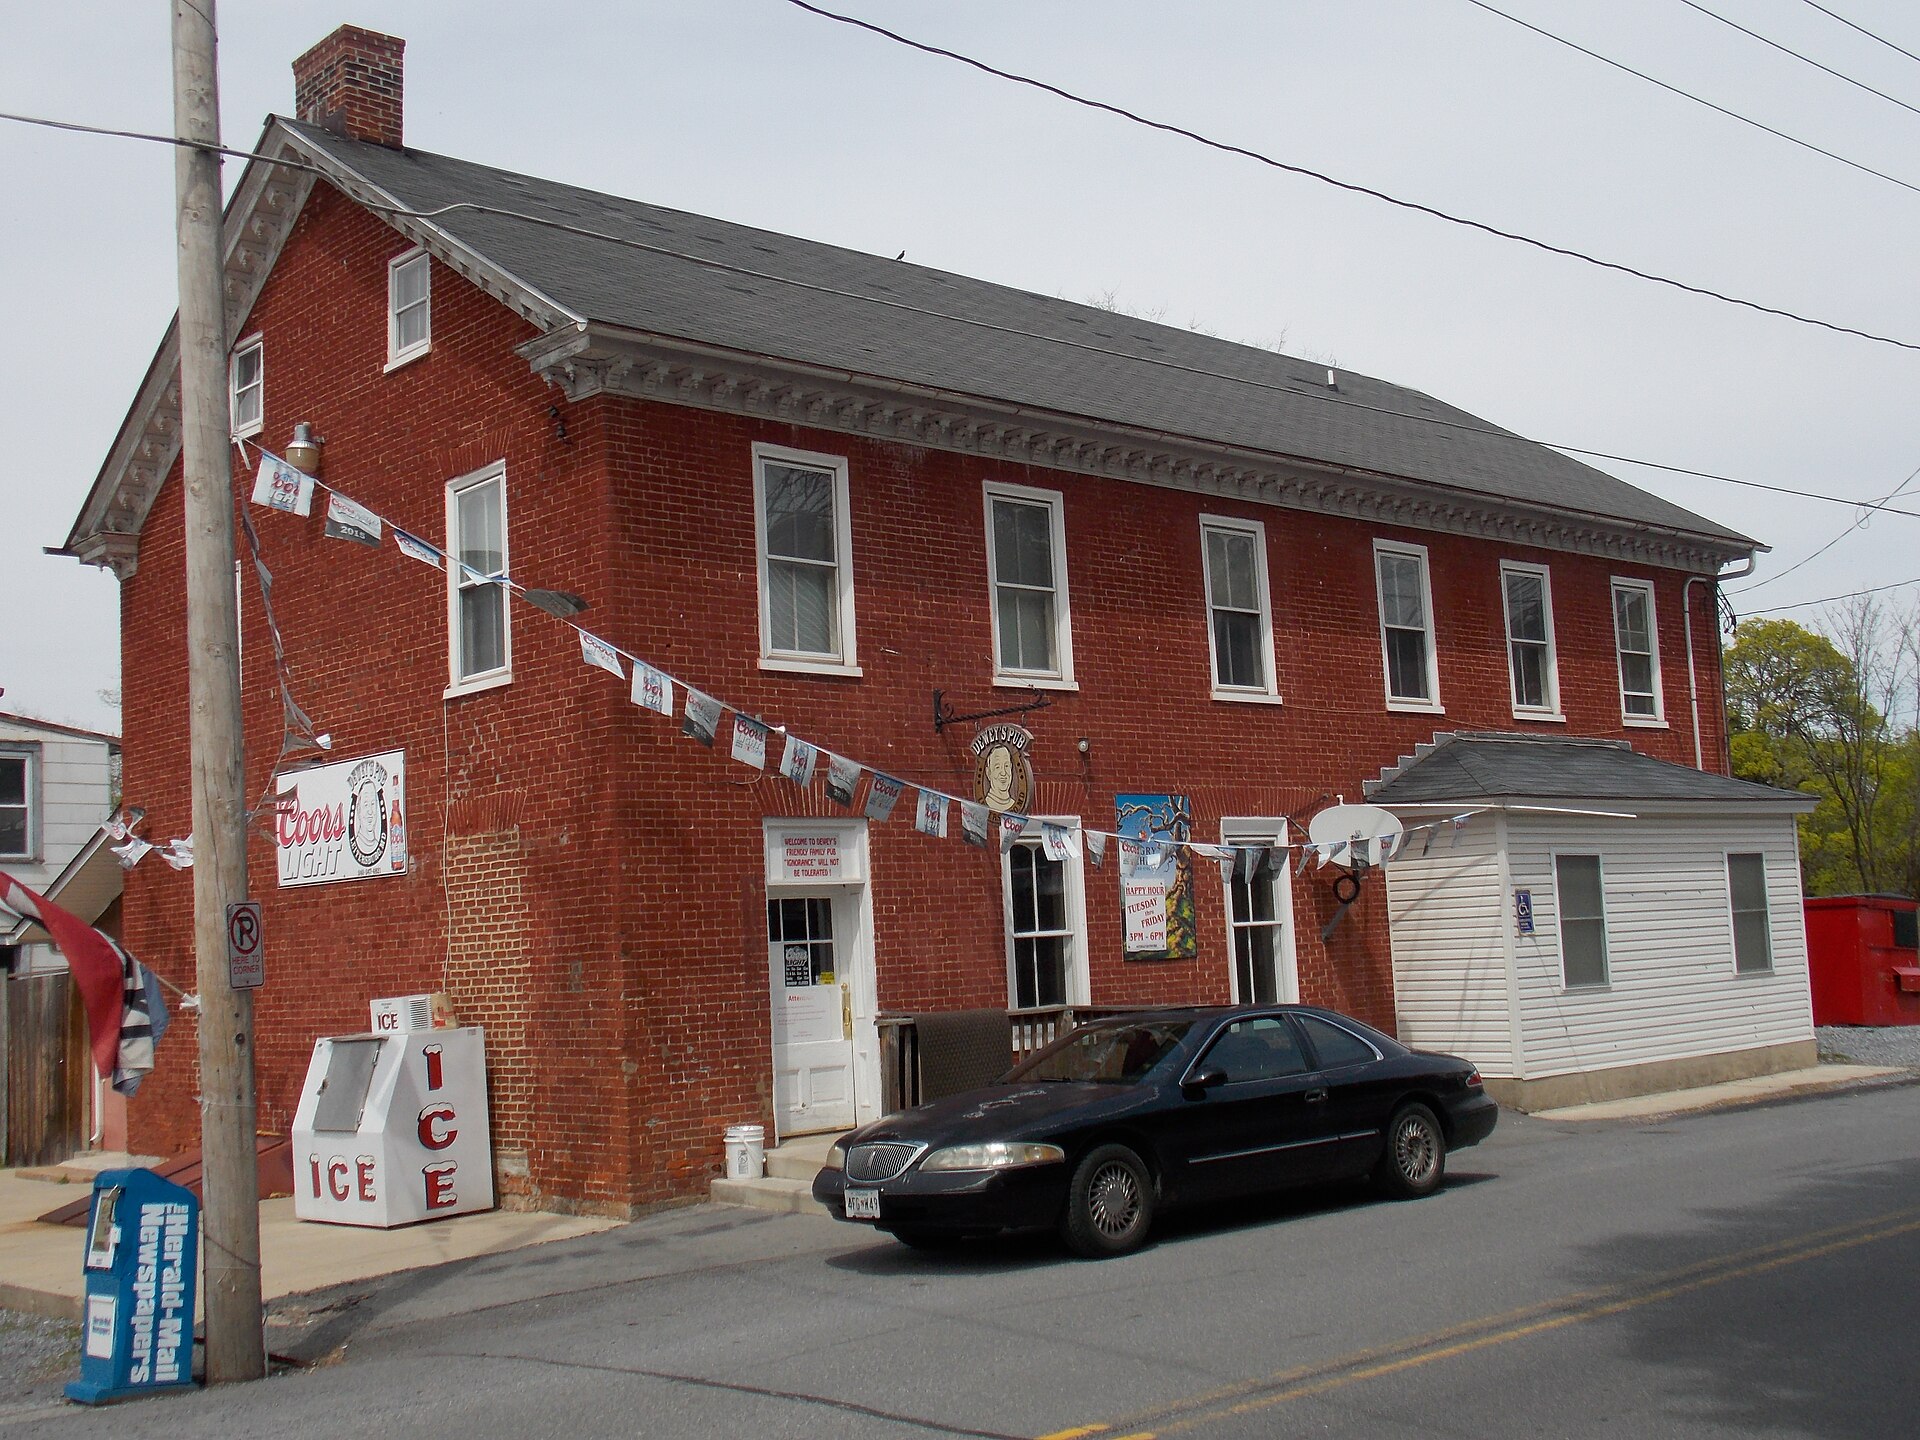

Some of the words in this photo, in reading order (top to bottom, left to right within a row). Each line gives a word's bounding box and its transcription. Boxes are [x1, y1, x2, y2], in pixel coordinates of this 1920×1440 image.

[340, 525, 366, 540] 2015
[737, 719, 763, 743] Coors
[972, 726, 1008, 755] DEWEY'S
[1008, 728, 1026, 749] PUB
[874, 777, 898, 798] Coors
[279, 798, 346, 849] Coors
[784, 838, 807, 846] WELCOME
[816, 837, 837, 845] DEWEY'S
[786, 848, 808, 856] FRIENDLY
[809, 848, 826, 856] FAMILY
[827, 848, 836, 856] PUB
[283, 843, 343, 880] LIGHT
[830, 858, 839, 866] NOT
[793, 869, 800, 877] BE
[1125, 886, 1146, 895] HAPPY
[1147, 886, 1165, 895] HOUR
[1127, 897, 1158, 914] TUESDAY
[1141, 913, 1165, 928] FRIDAY
[1129, 932, 1144, 941] 3PM
[1150, 931, 1164, 941] 6PM
[232, 955, 249, 965] HERE
[252, 955, 260, 964] TO
[233, 964, 260, 975] CORNER
[377, 1013, 399, 1031] ICE
[417, 1043, 458, 1211] ICE
[309, 1152, 377, 1203] ICE
[130, 1203, 165, 1383] Newspapers
[155, 1213, 189, 1382] Herald-Mail
